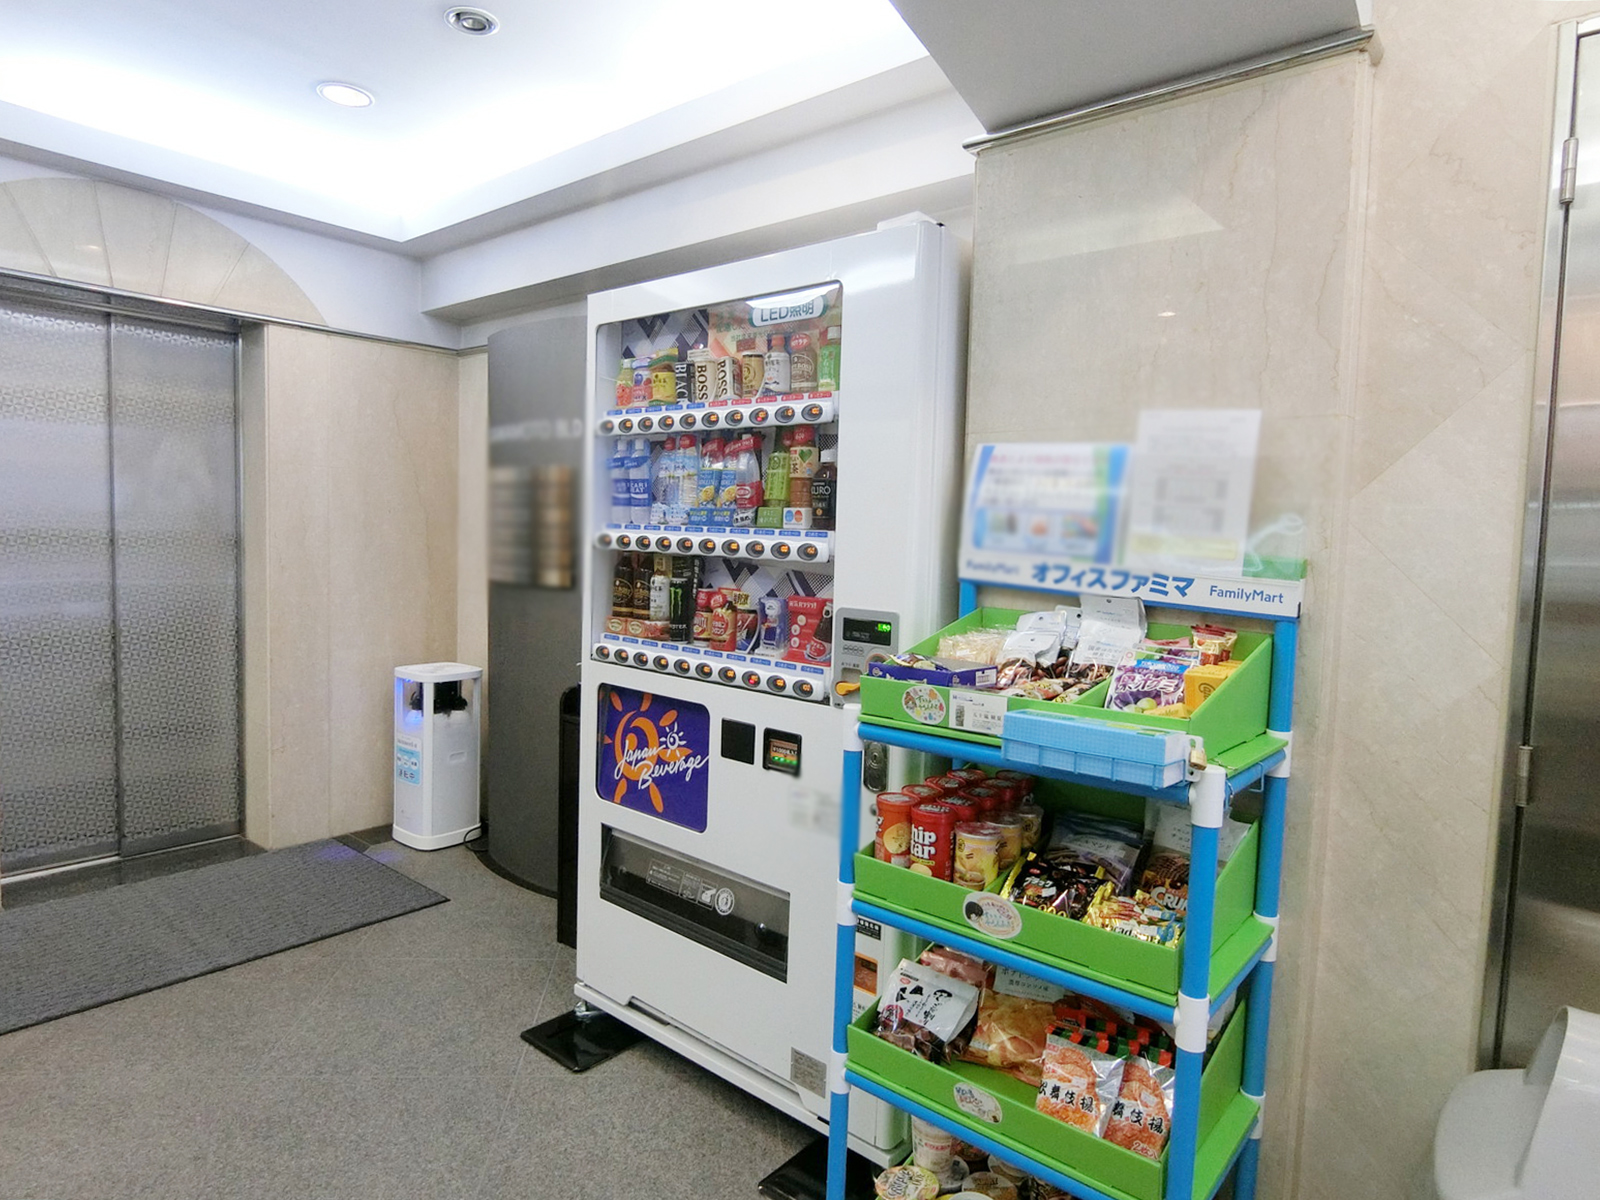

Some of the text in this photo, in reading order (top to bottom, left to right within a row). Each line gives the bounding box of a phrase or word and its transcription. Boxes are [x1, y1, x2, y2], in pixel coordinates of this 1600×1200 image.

[760, 299, 814, 322] LED照明
[696, 364, 708, 402] BOSS
[716, 360, 728, 399] BOSS
[1032, 563, 1195, 598] オフィスファミマ
[1209, 585, 1284, 605] FamilyMart
[1116, 674, 1178, 693] 果汁グミ
[615, 739, 666, 780] Japan
[635, 755, 710, 790] Beverage
[910, 839, 936, 860] tar
[911, 823, 937, 846] hip
[1112, 1099, 1165, 1135] 舞伎揚
